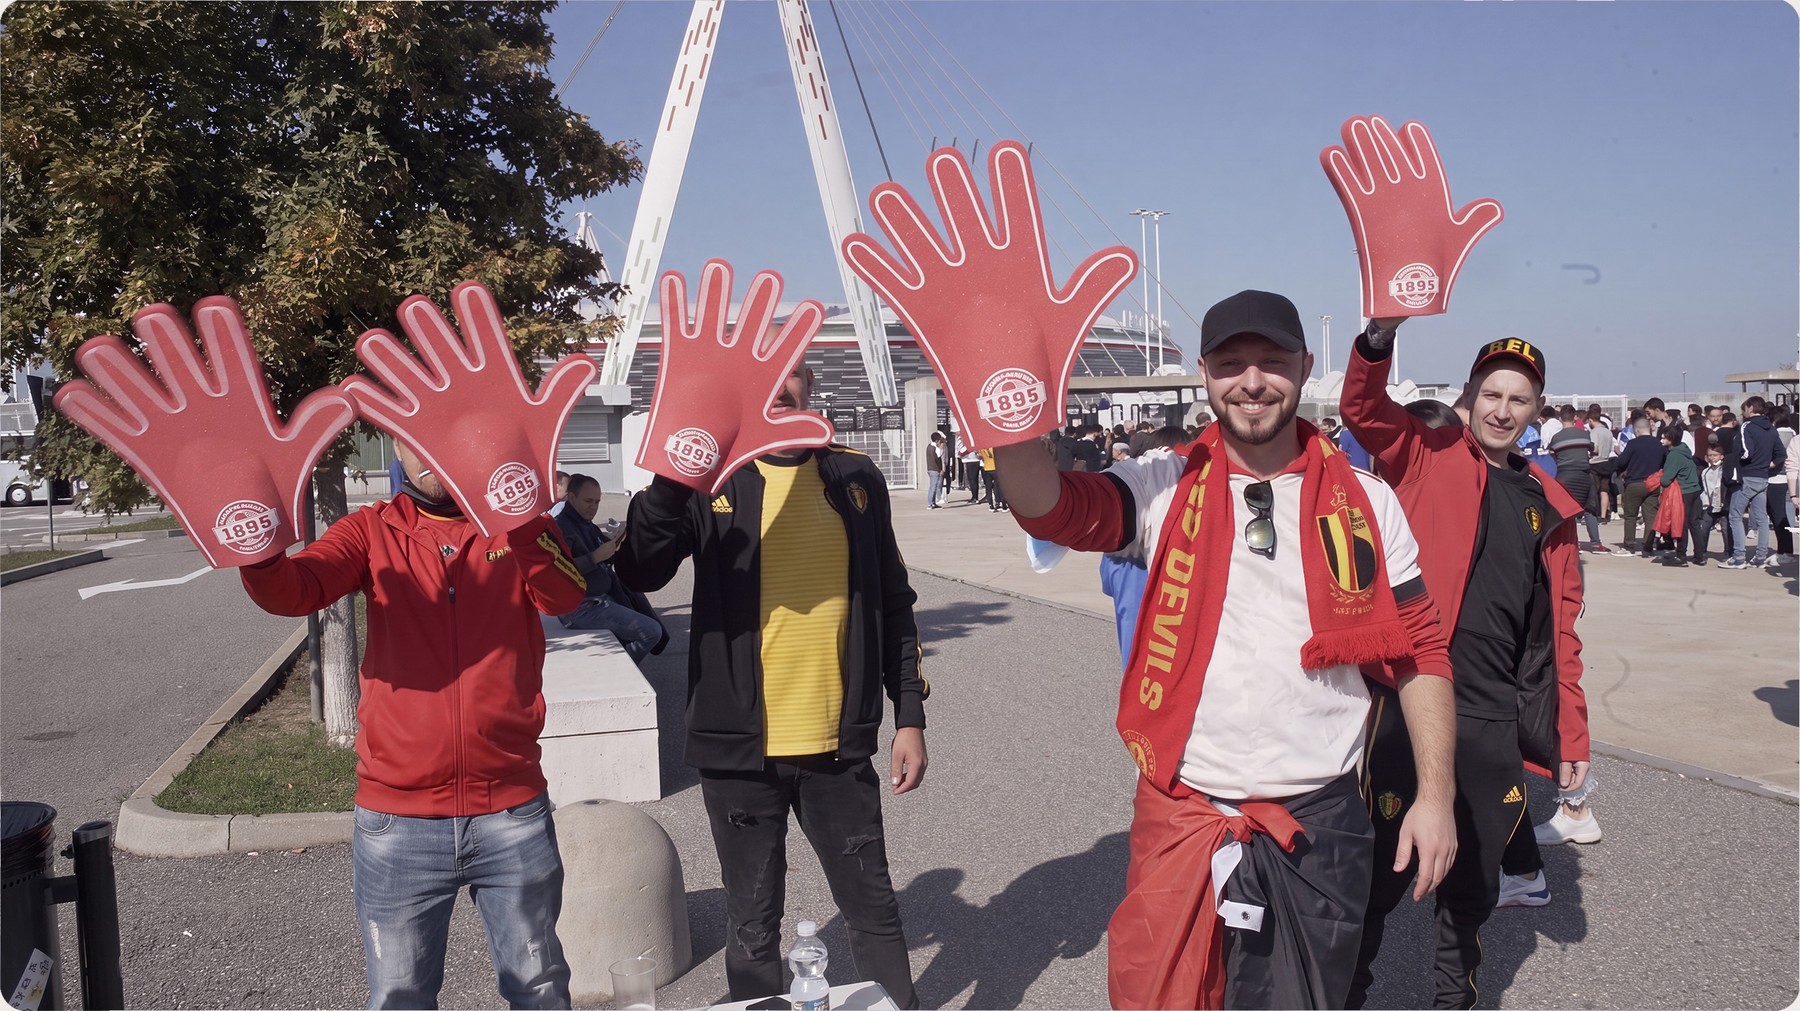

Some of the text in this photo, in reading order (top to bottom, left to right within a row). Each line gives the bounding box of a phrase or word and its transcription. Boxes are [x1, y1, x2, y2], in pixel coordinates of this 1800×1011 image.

[1396, 280, 1435, 293] 1895
[1489, 339, 1536, 362] BEL
[986, 387, 1039, 414] 1895
[672, 440, 714, 466] 1895
[493, 475, 535, 505] 1895
[222, 514, 272, 541] 1895
[1139, 547, 1196, 711] DEVILS
